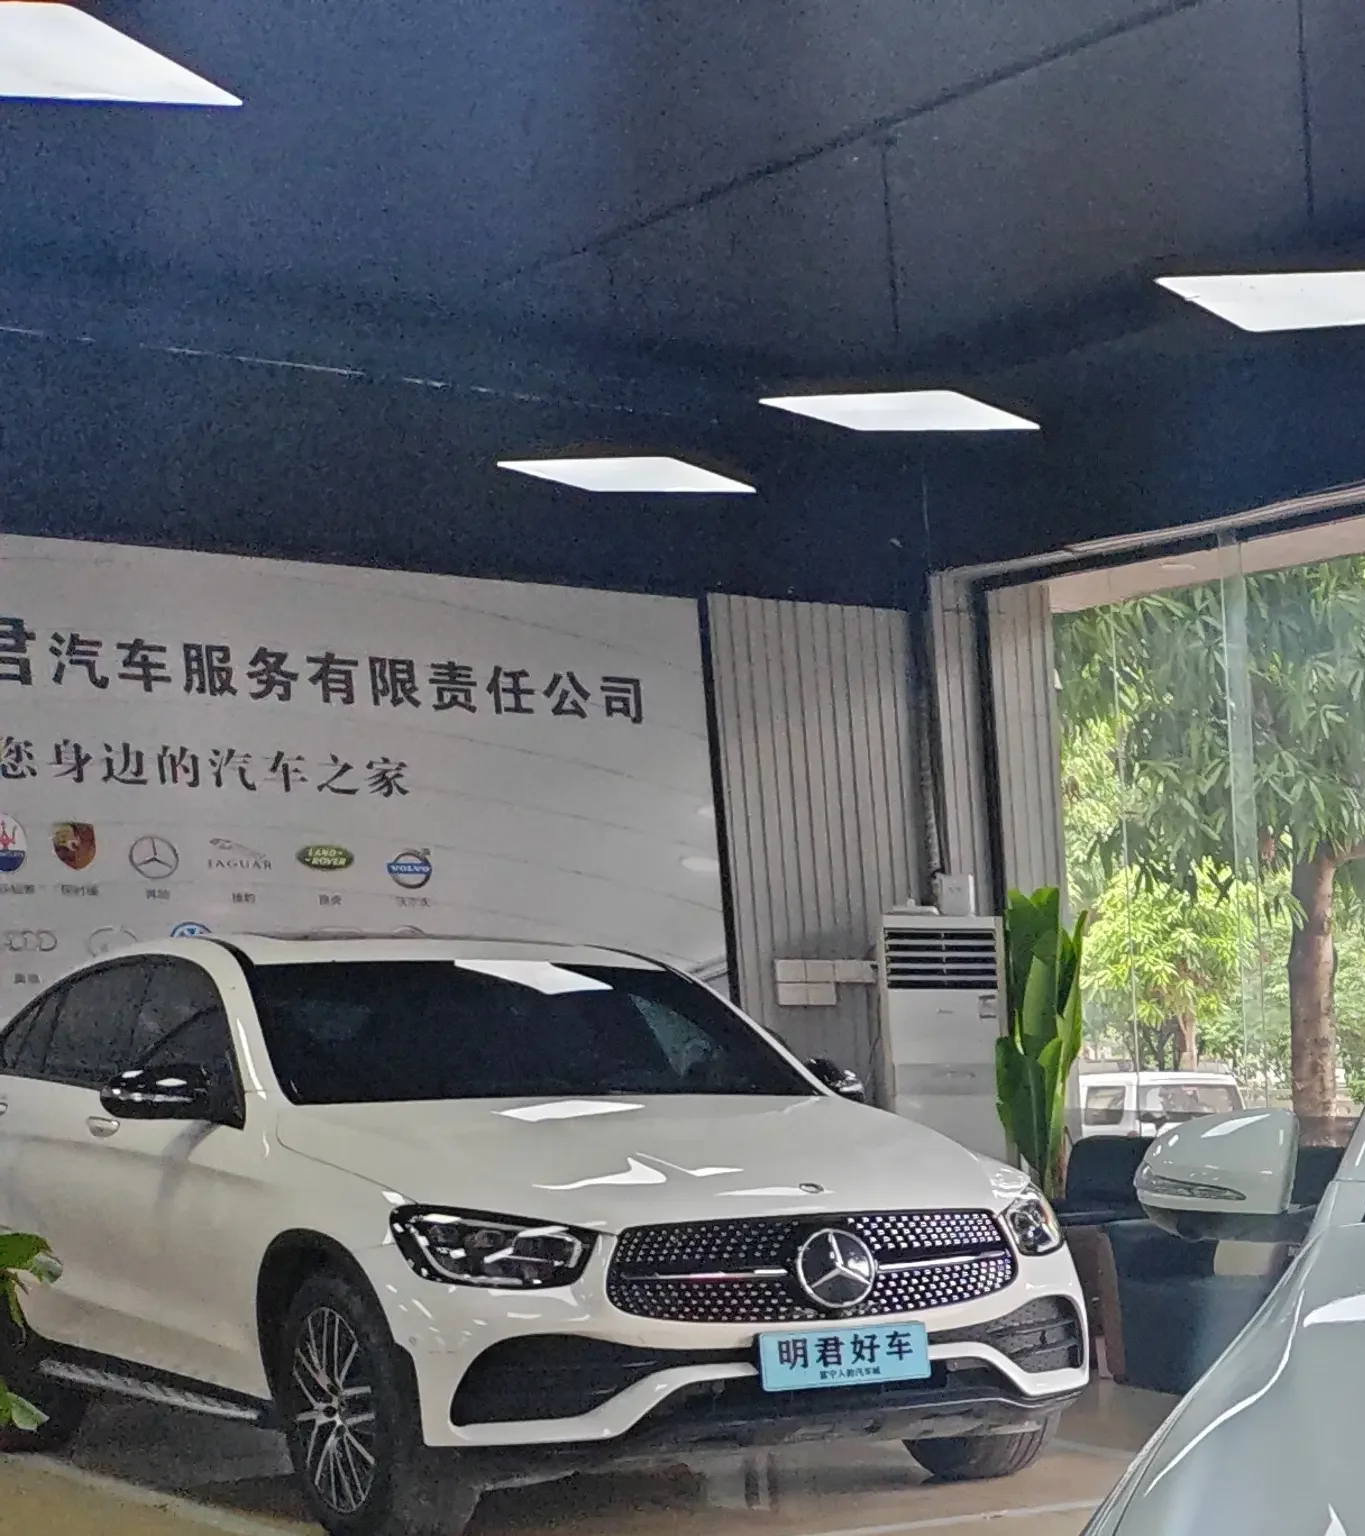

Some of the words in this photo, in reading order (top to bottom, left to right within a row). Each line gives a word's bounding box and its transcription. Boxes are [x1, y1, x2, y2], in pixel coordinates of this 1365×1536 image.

[0, 736, 410, 797] 您身边的汽车之家
[207, 858, 273, 871] JAGUAR
[390, 864, 430, 873] VOLVO
[778, 1330, 914, 1370] 明君好车
